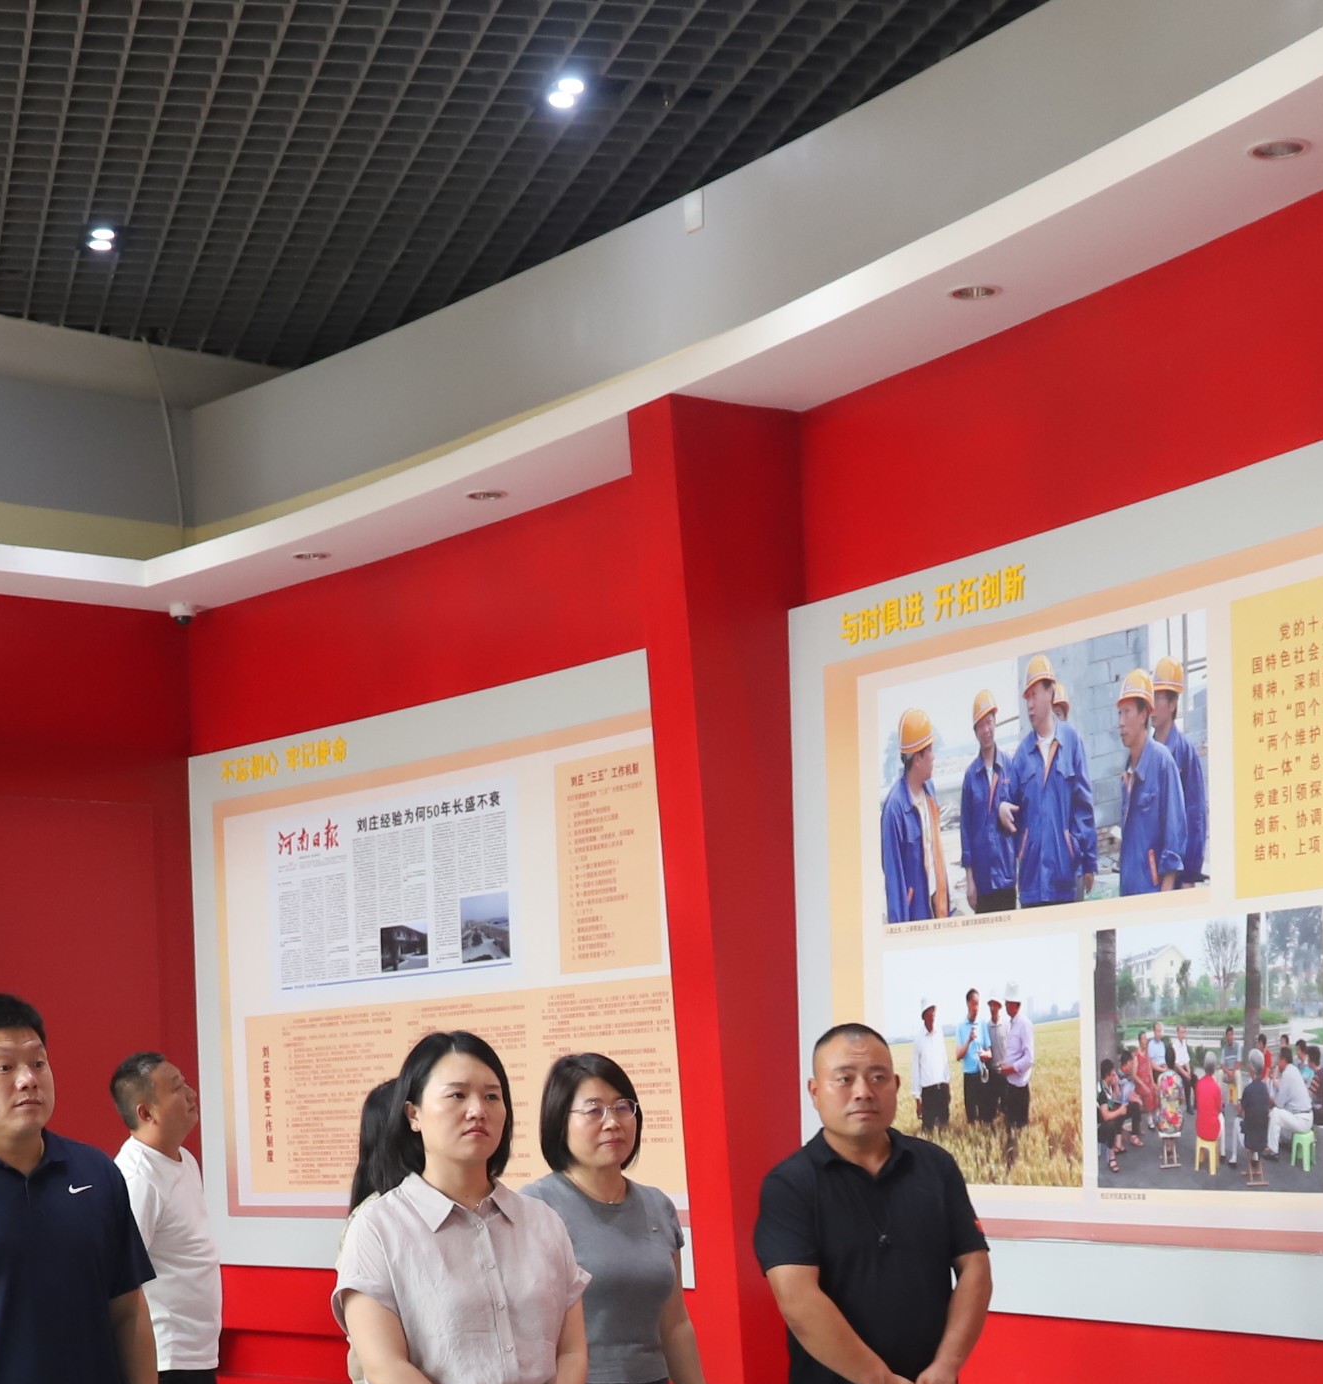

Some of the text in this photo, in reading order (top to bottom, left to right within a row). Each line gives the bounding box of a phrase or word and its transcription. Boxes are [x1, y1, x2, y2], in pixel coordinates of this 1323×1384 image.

[840, 563, 1026, 645] 与时俱进 开拓创新
[220, 736, 347, 784] 不忘初心 牢记使命
[356, 791, 501, 833] 刘庄经验为何50年长盛不衰
